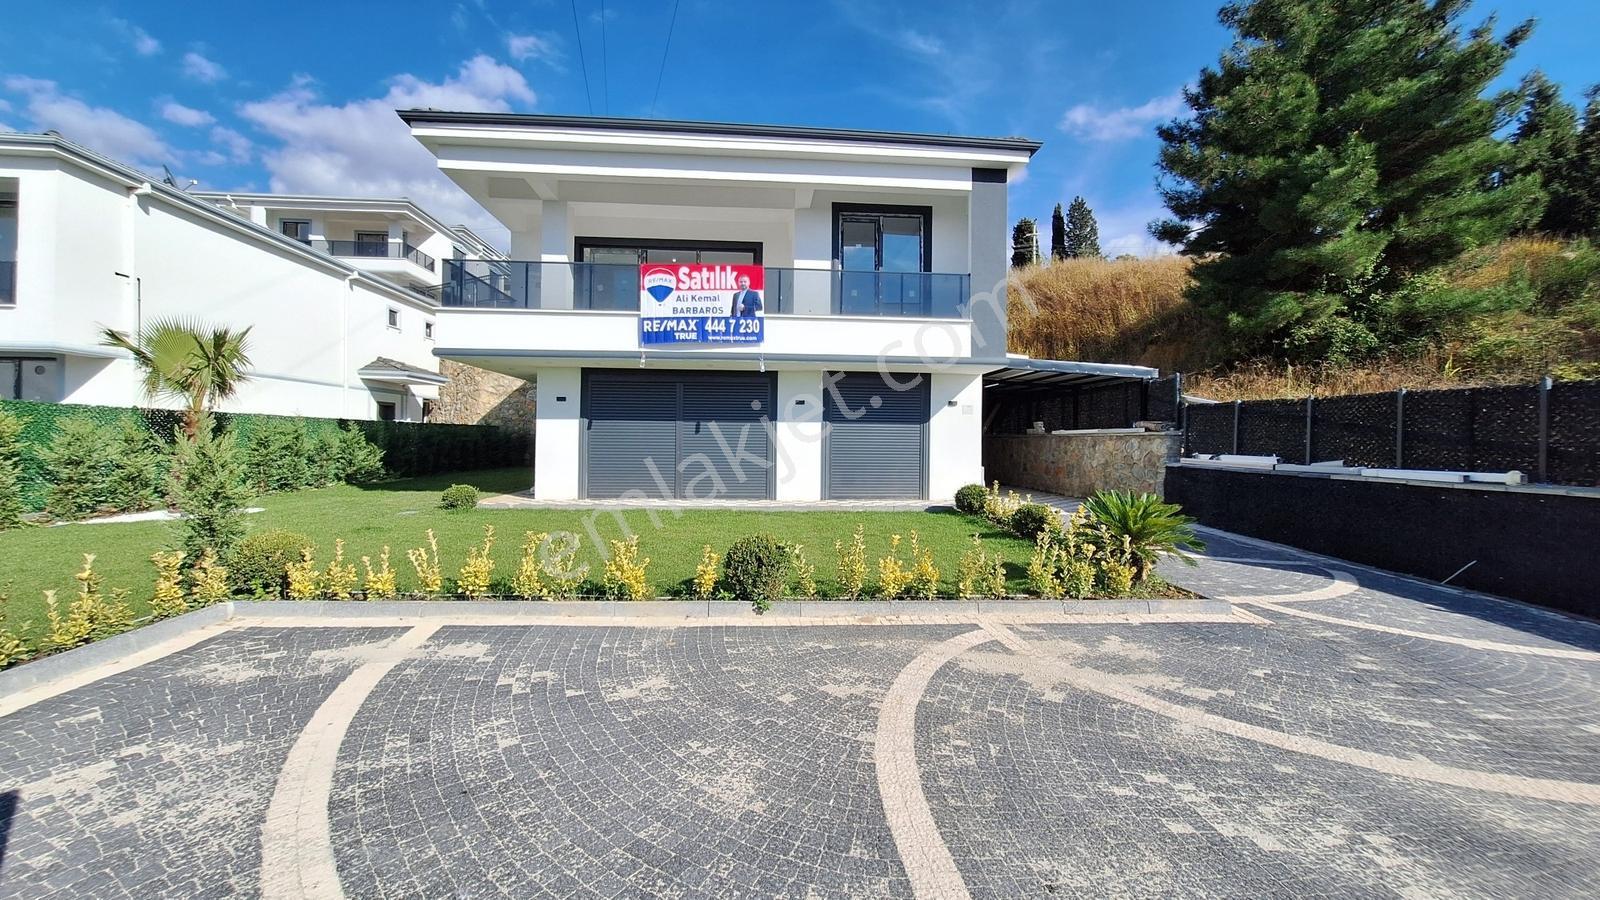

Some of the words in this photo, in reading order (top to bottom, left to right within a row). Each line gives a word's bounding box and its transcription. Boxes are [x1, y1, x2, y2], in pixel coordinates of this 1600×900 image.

[678, 266, 738, 290] Satılık
[691, 294, 720, 302] Kemal
[672, 306, 724, 314] BARBAROS
[643, 320, 697, 332] RE/MAX
[704, 320, 726, 333] 444
[729, 320, 736, 333] 7
[739, 319, 760, 333] 230
[674, 332, 697, 340] TRUE
